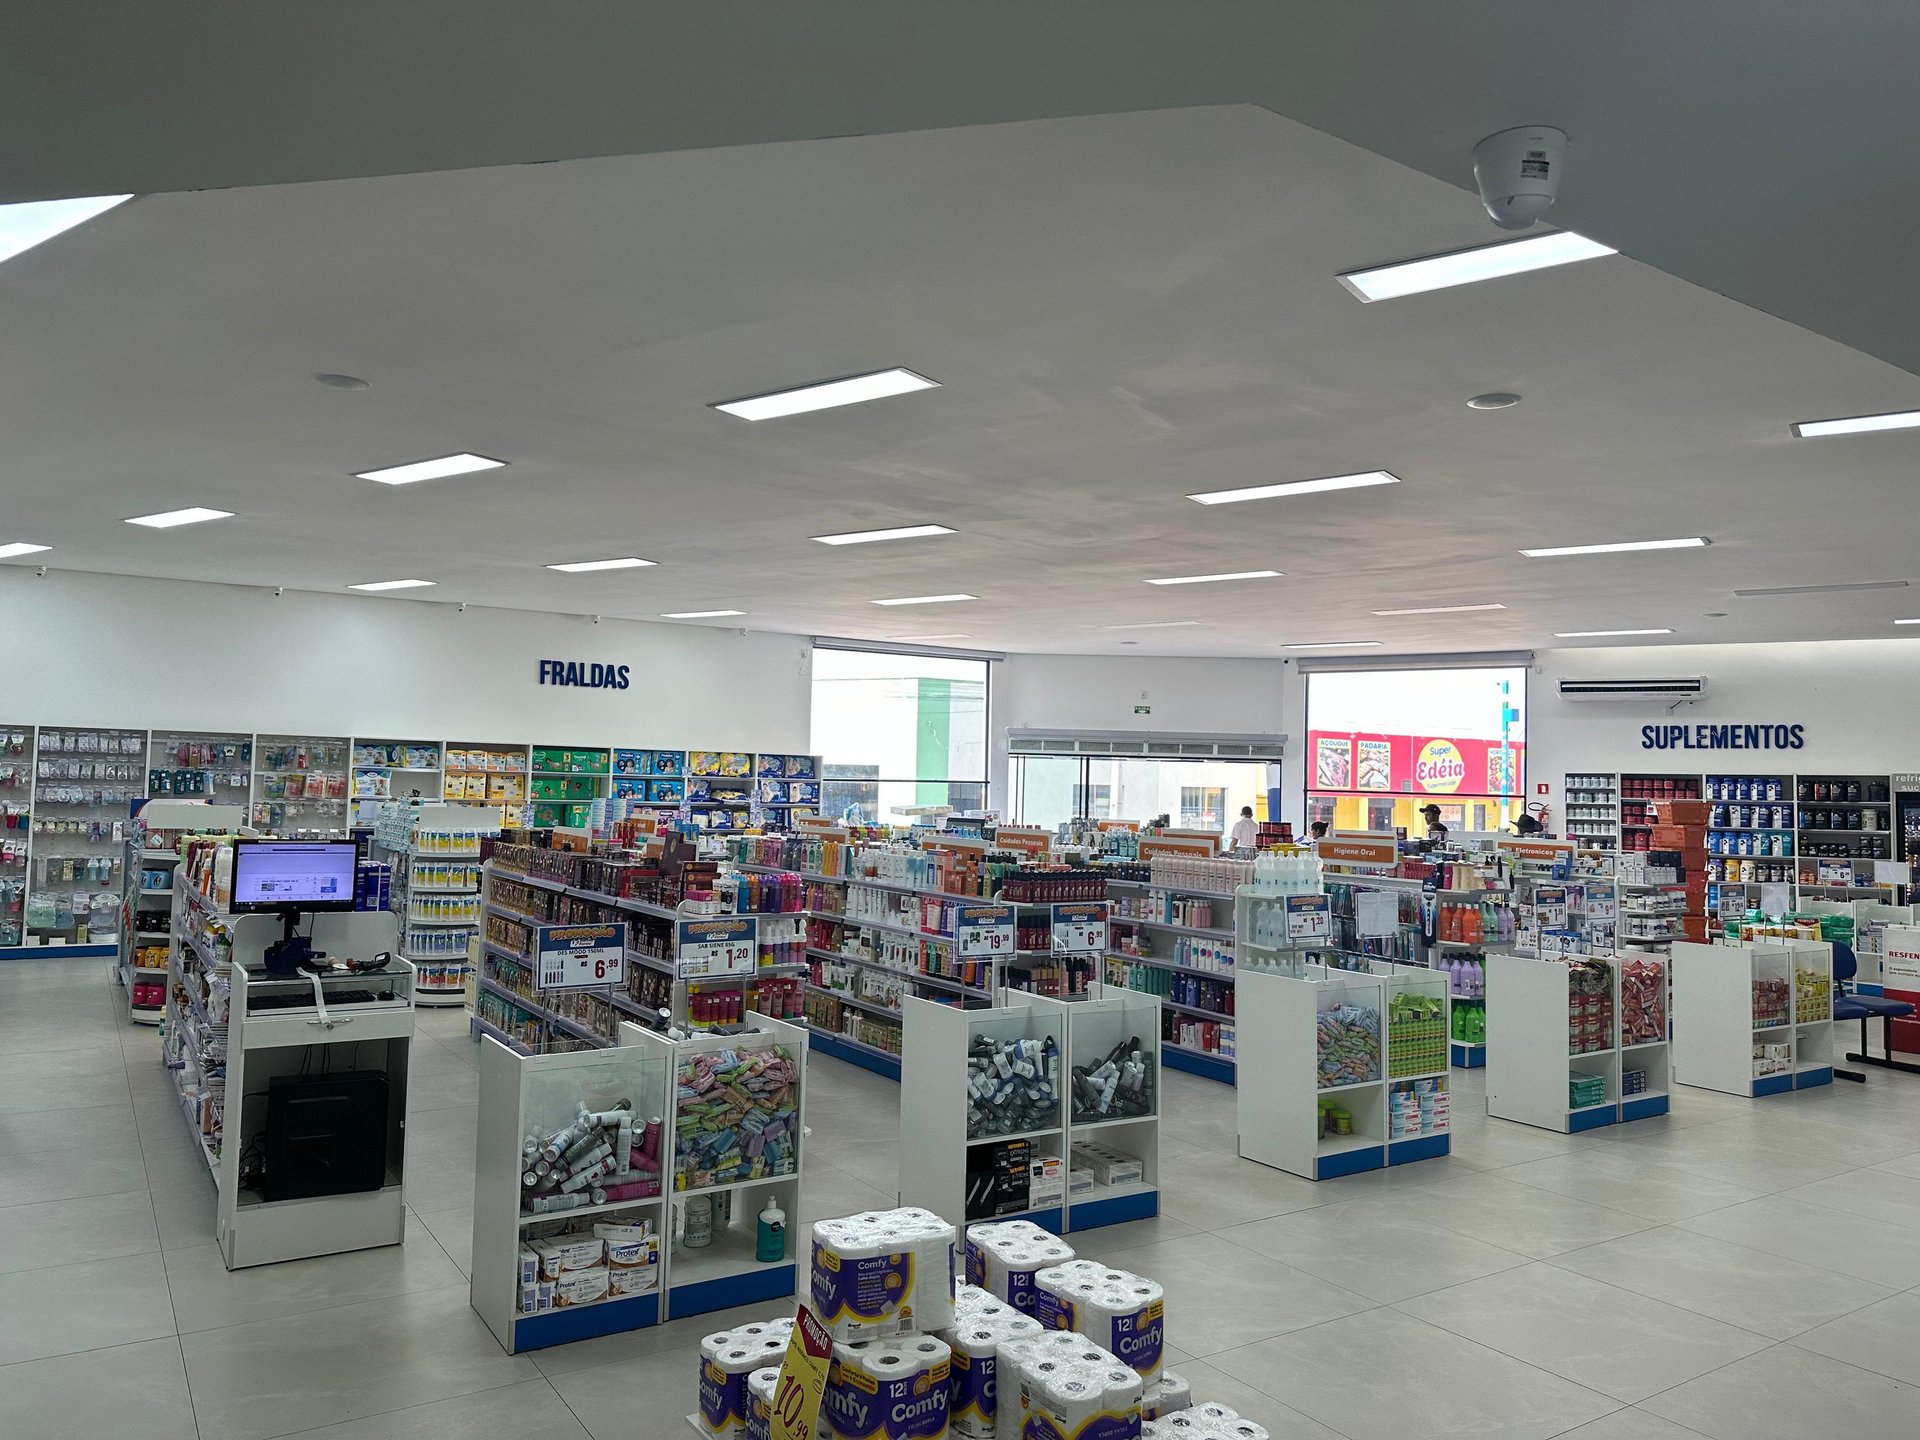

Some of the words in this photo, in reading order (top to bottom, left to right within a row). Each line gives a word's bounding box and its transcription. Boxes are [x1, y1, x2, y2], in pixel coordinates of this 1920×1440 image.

[539, 659, 630, 690] FRALDAS
[1320, 739, 1349, 747] AÇOUGUE
[1641, 723, 1804, 750] SUPLEMENTOS
[1360, 742, 1388, 750] PADARIA
[1429, 746, 1452, 757] Super
[1417, 758, 1463, 781] Edéia
[1895, 773, 1920, 783] refri
[1000, 837, 1022, 845] Cuidados
[1022, 838, 1043, 847] Pessoais
[1333, 847, 1359, 856] Higiene
[1360, 848, 1376, 856] Oral
[549, 925, 616, 941] PROMOÇÃO
[687, 920, 748, 935] PROMOÇÃO
[989, 934, 1010, 949] 19,99
[726, 947, 749, 969] 1,20
[1888, 950, 1920, 960] RESFEN
[594, 959, 619, 980] 6,99
[616, 1248, 640, 1258] Protex
[858, 1259, 887, 1270] Comfy
[612, 1270, 629, 1278] Protex
[1013, 1274, 1025, 1287] 12
[560, 1281, 576, 1289] Protex
[811, 1269, 837, 1301] omfy
[1039, 1291, 1059, 1307] Comfy
[803, 1314, 829, 1351] PROMOÇÃO
[1117, 1318, 1130, 1332] 12
[1119, 1326, 1162, 1355] Comfy
[980, 1360, 995, 1375] 12
[700, 1381, 723, 1410] omfy
[889, 1382, 904, 1398] 12
[891, 1389, 949, 1423] Comfy
